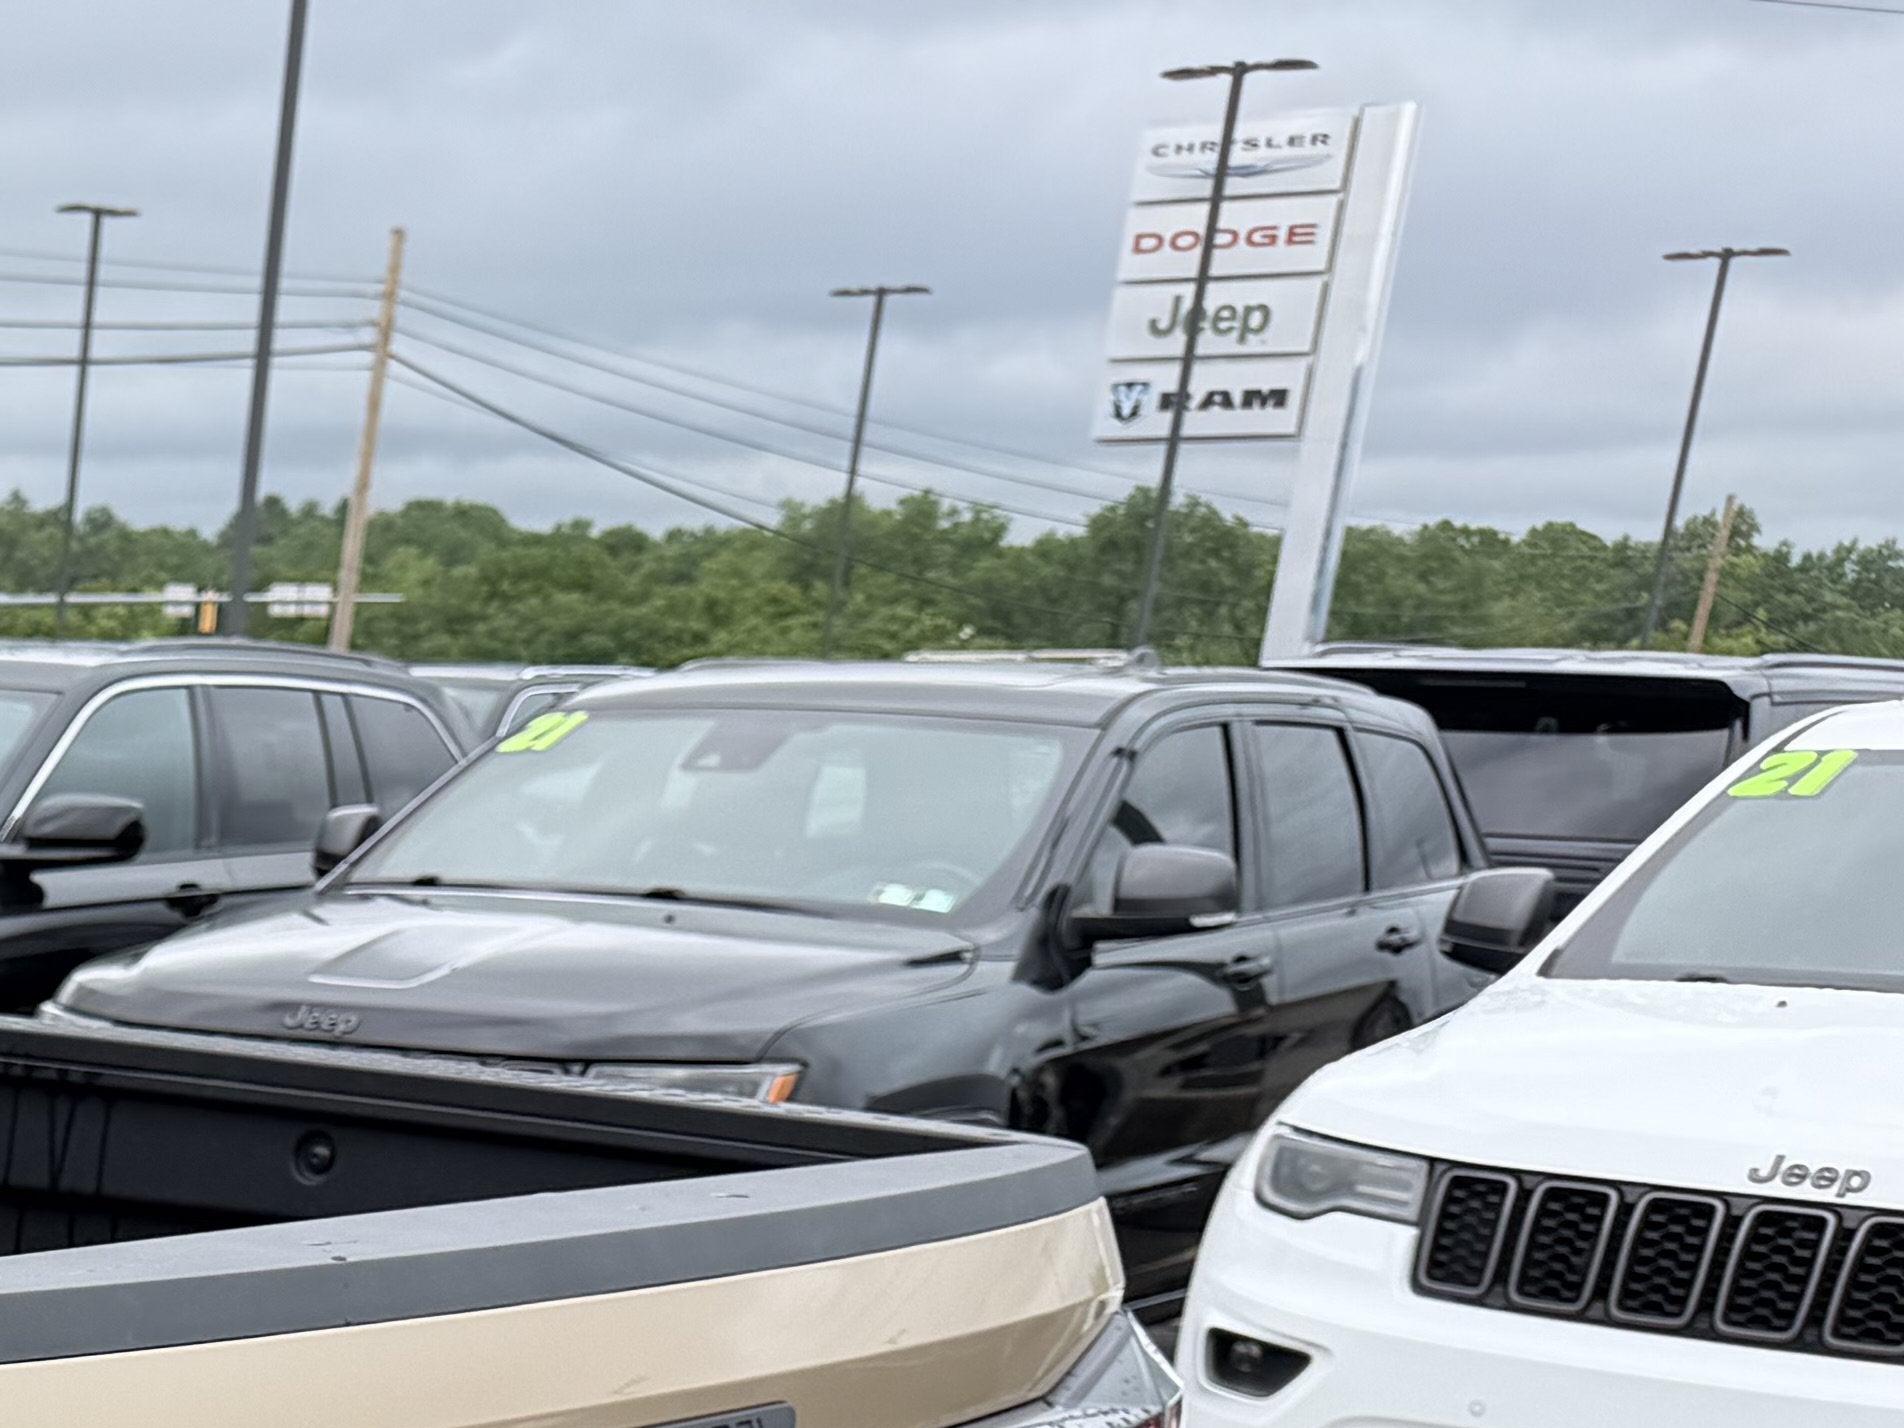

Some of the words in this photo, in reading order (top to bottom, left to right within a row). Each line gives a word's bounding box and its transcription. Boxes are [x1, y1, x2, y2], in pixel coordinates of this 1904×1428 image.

[1150, 132, 1332, 158] CHRSLER
[1131, 223, 1320, 255] DODGE
[495, 710, 590, 752] 21
[1727, 750, 1858, 798] 21
[283, 1005, 360, 1036] Jeep
[1747, 1155, 1872, 1198] Jeep
